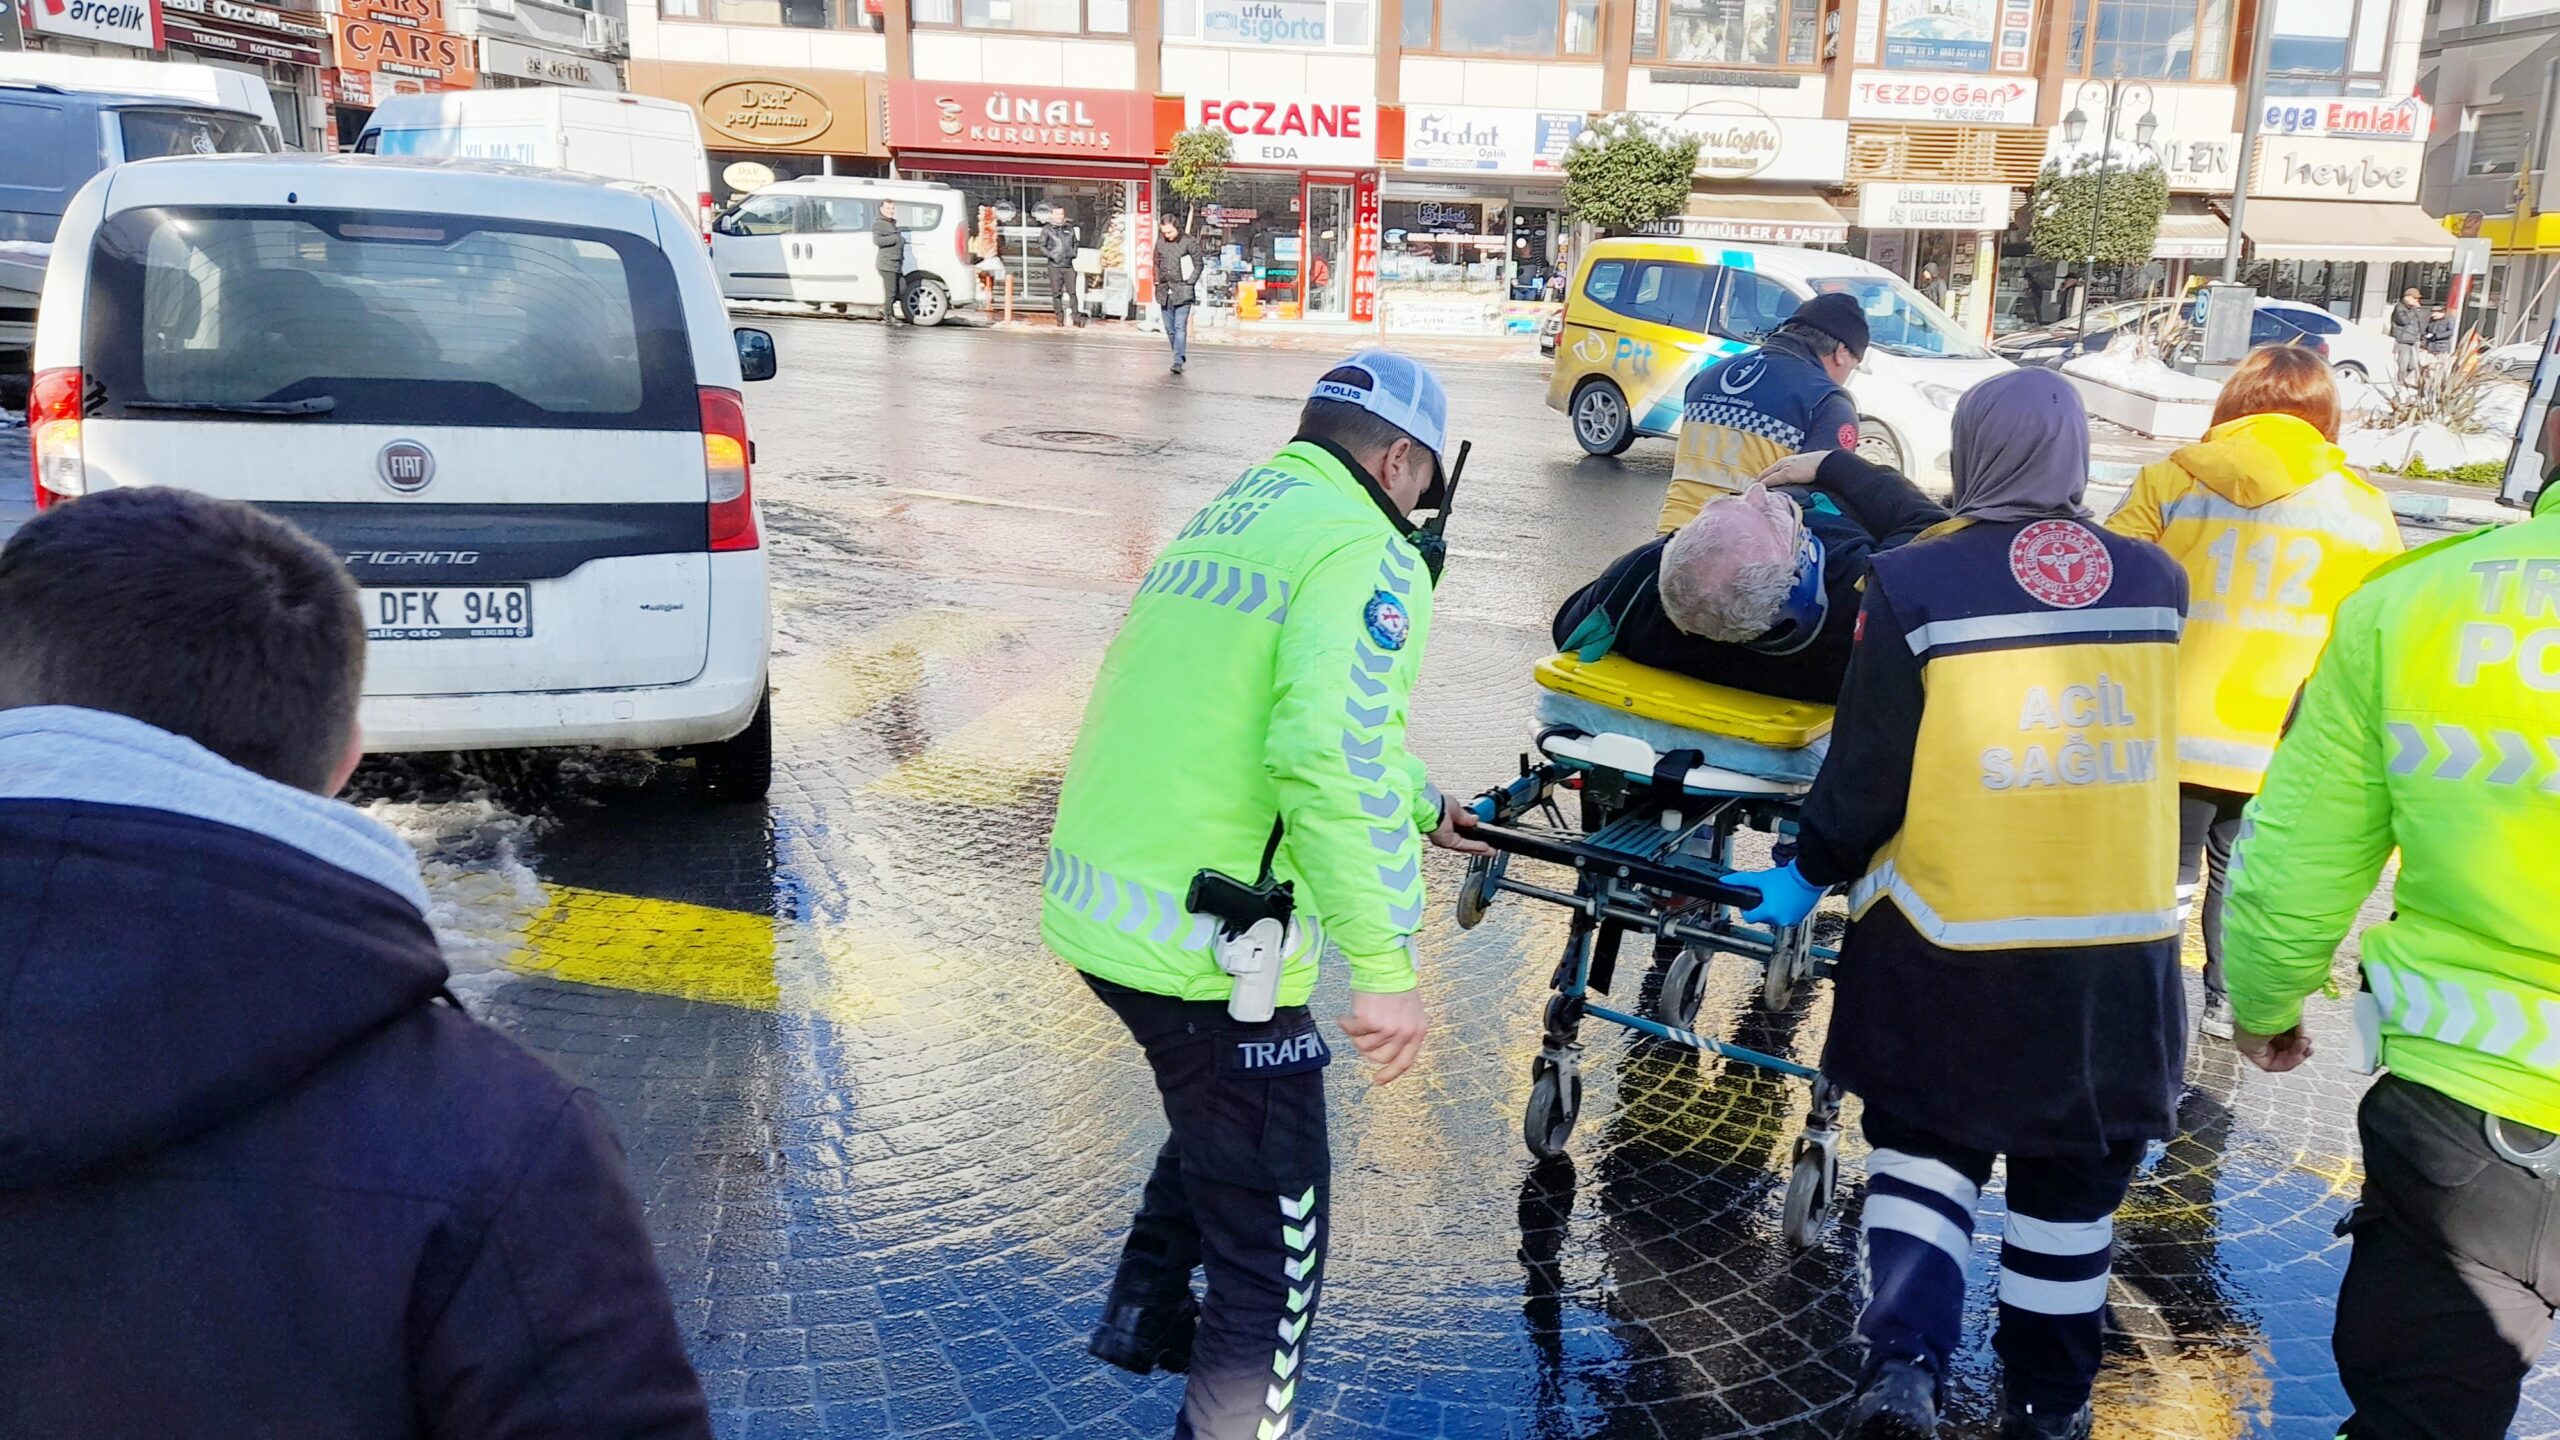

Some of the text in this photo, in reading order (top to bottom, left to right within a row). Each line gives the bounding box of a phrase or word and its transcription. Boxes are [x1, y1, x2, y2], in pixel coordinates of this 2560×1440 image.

[71, 0, 144, 31] arçelik
[1242, 4, 1283, 19] ufuk
[1239, 17, 1325, 43] sigorta
[345, 24, 471, 73] ÇARŞI
[740, 87, 797, 110] D&P
[1859, 83, 2007, 108] TEZDOĞAN
[725, 109, 808, 130] perfumum
[985, 90, 1095, 128] ÜNAL
[2265, 103, 2412, 132] ega Emlak
[970, 124, 1112, 150] KURUYEMİŞ
[1261, 146, 1298, 160] EDA
[2283, 151, 2409, 194] heybe
[1898, 188, 1982, 204] BELEDİYE
[1910, 206, 1987, 224] MERKEZİ
[1775, 227, 1787, 240] &
[1792, 227, 1844, 242] PASTA
[1323, 384, 1361, 400] POLİS
[392, 455, 423, 478] FIAT
[1213, 468, 1313, 502] AFİK
[1176, 502, 1271, 541] OLİSİ
[344, 550, 481, 565] FIORINO
[2207, 527, 2323, 608] 112
[380, 591, 523, 625] DFK 948
[407, 629, 442, 638] oto
[2019, 671, 2136, 731] ACİL
[1980, 733, 2158, 791] SAĞLIK
